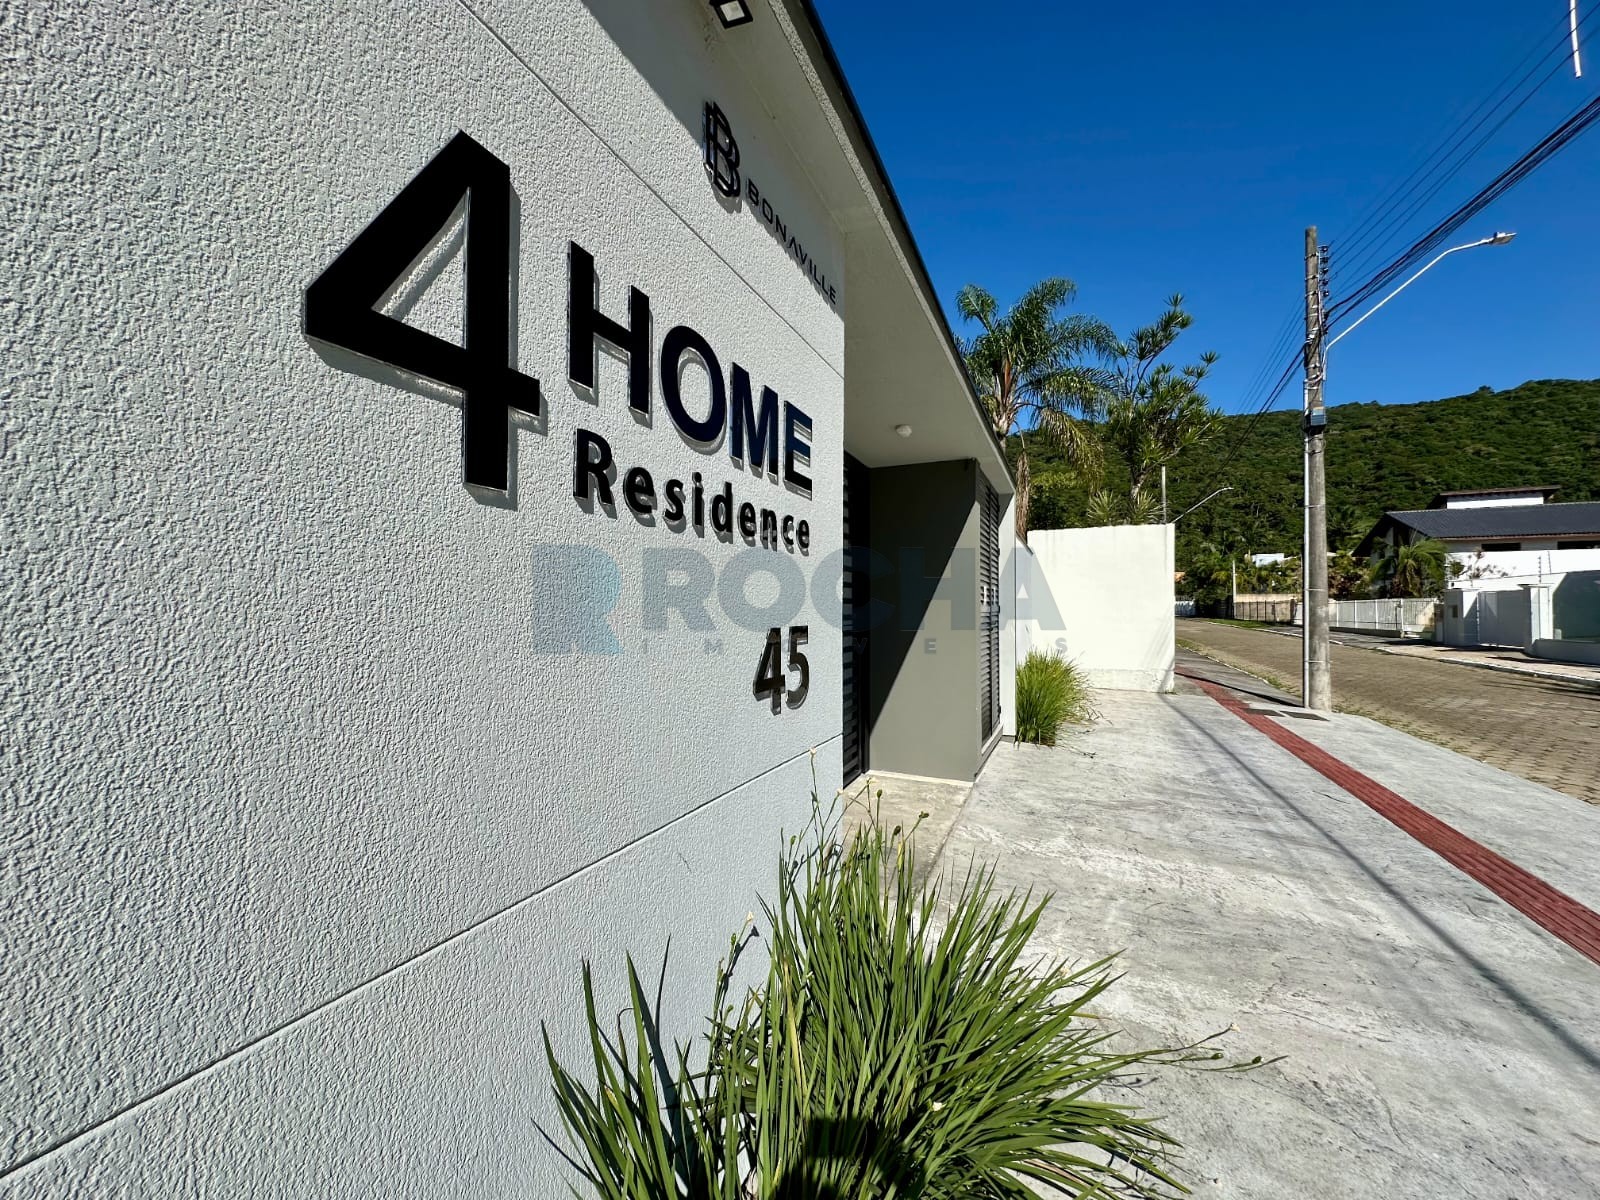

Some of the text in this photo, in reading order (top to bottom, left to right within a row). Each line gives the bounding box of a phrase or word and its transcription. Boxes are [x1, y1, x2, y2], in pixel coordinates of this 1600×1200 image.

[747, 178, 837, 305] BONAVILLE
[305, 129, 813, 500] 4 HOME
[573, 428, 811, 550] Residence
[753, 625, 810, 716] 45
